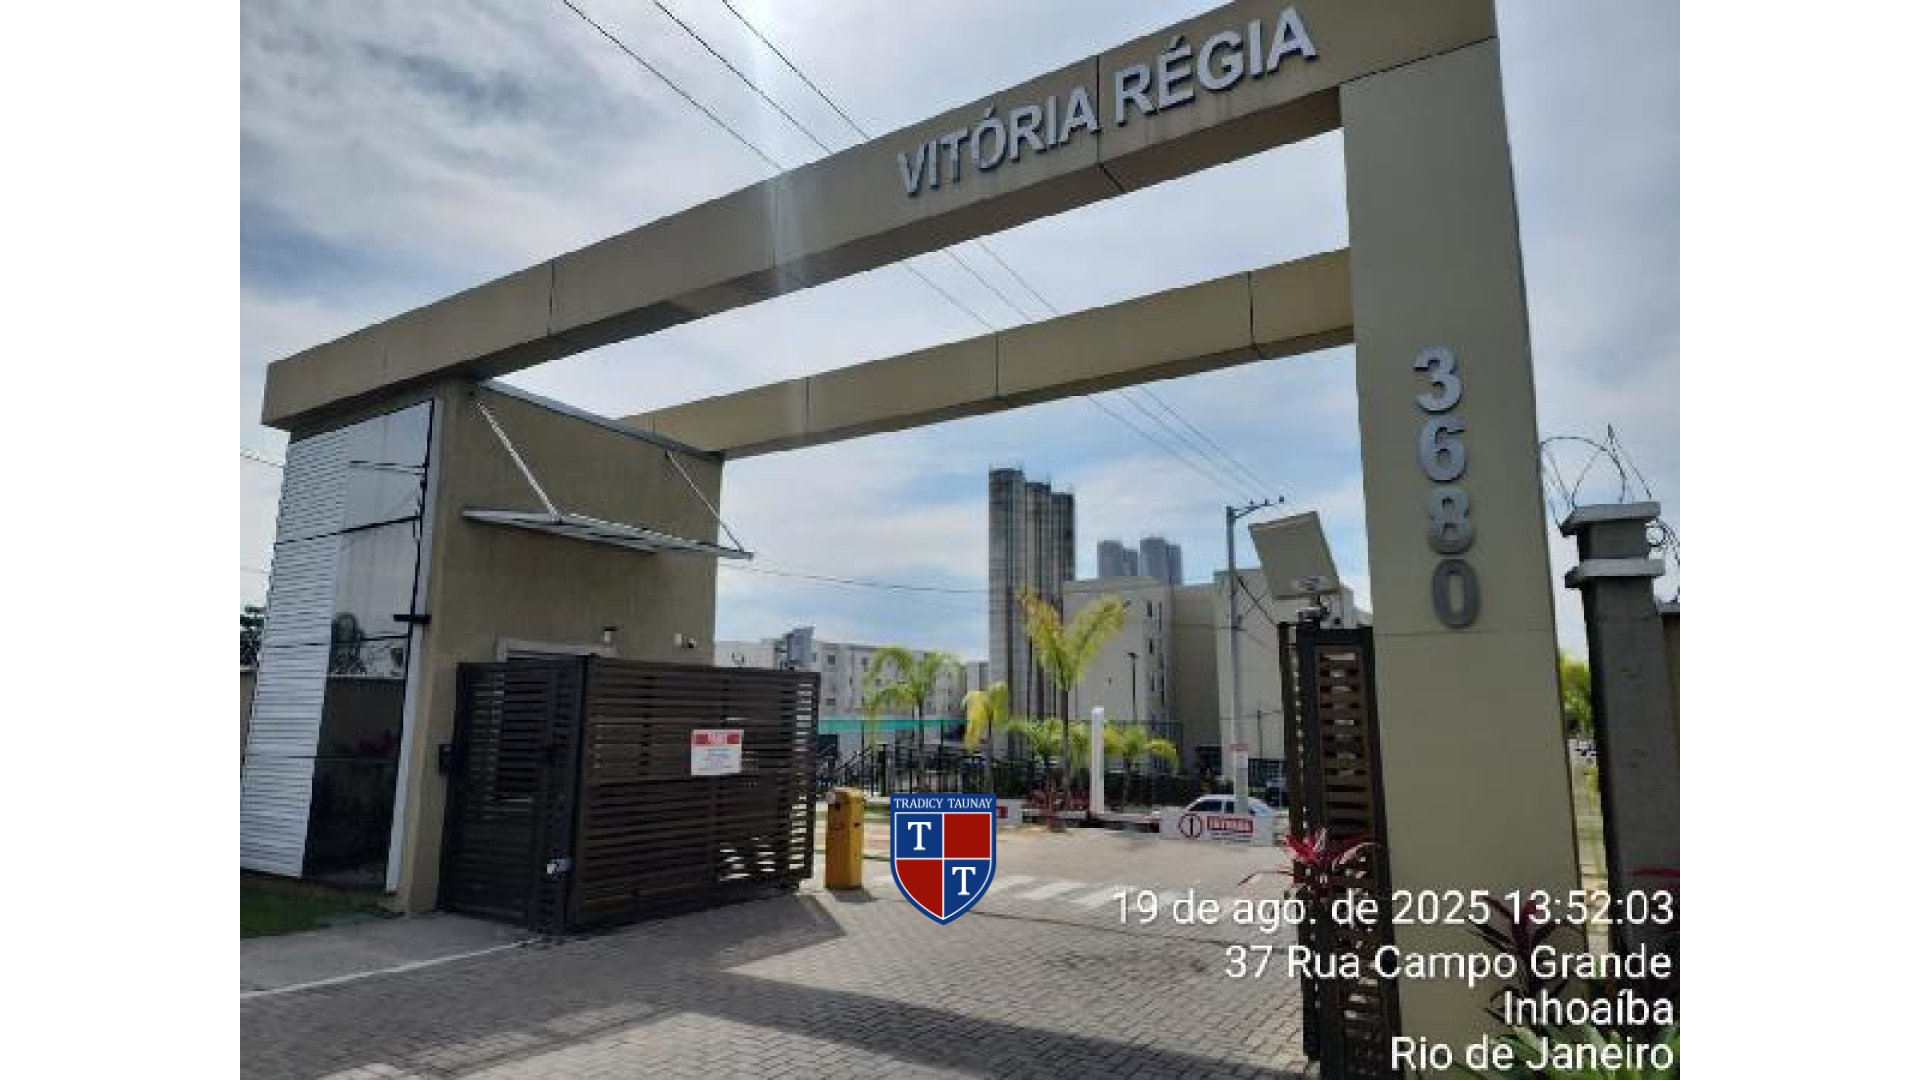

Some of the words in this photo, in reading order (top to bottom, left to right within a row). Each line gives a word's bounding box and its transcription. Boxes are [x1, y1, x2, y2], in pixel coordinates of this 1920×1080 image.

[898, 85, 1099, 197] VITÓRIA
[1114, 6, 1318, 126] RÉGIA
[1413, 346, 1480, 630] 3680
